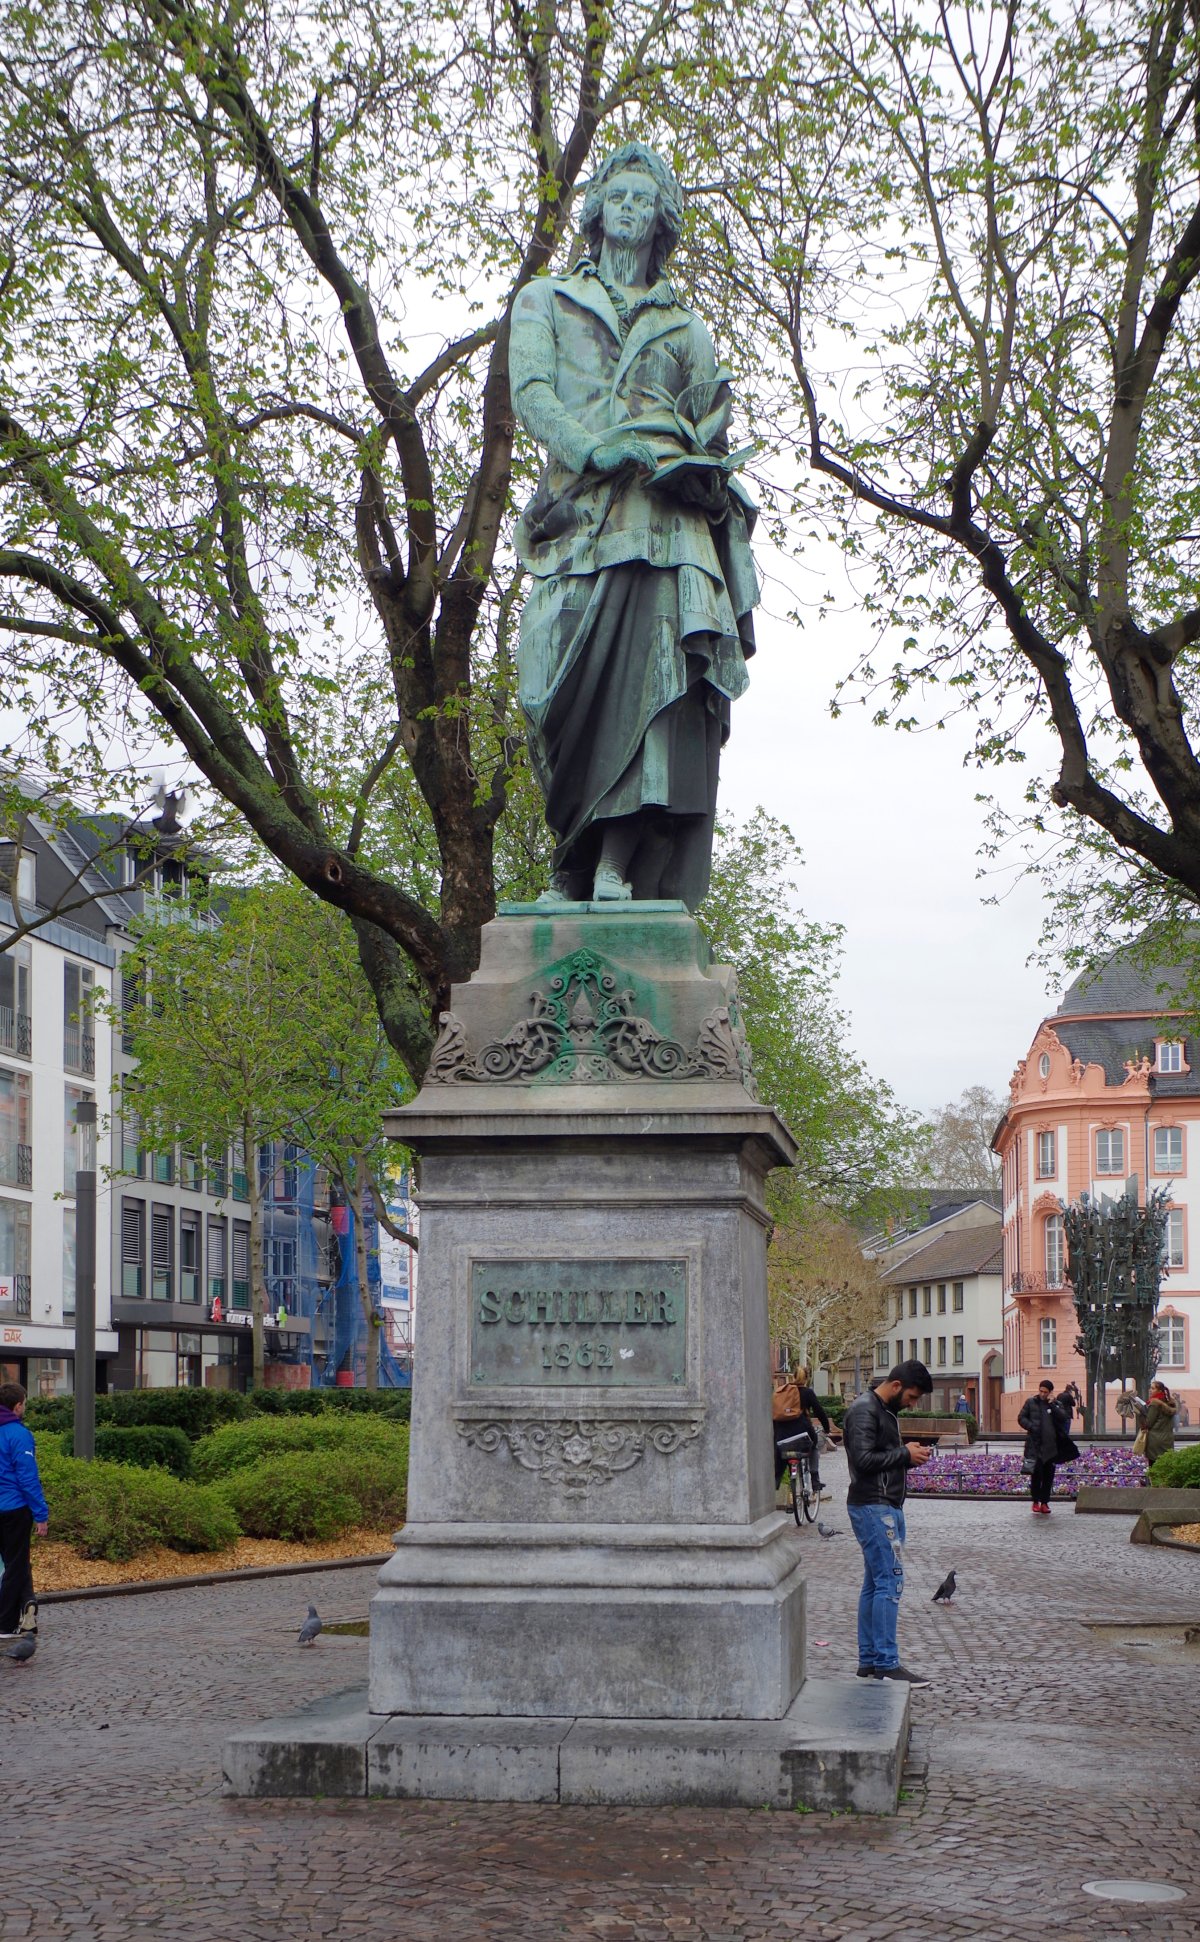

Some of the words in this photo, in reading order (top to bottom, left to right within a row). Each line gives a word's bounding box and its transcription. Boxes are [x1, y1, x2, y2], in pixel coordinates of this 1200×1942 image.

[479, 1290, 677, 1325] SCHILLER
[4, 1328, 22, 1343] DAK
[542, 1343, 614, 1368] 1862
